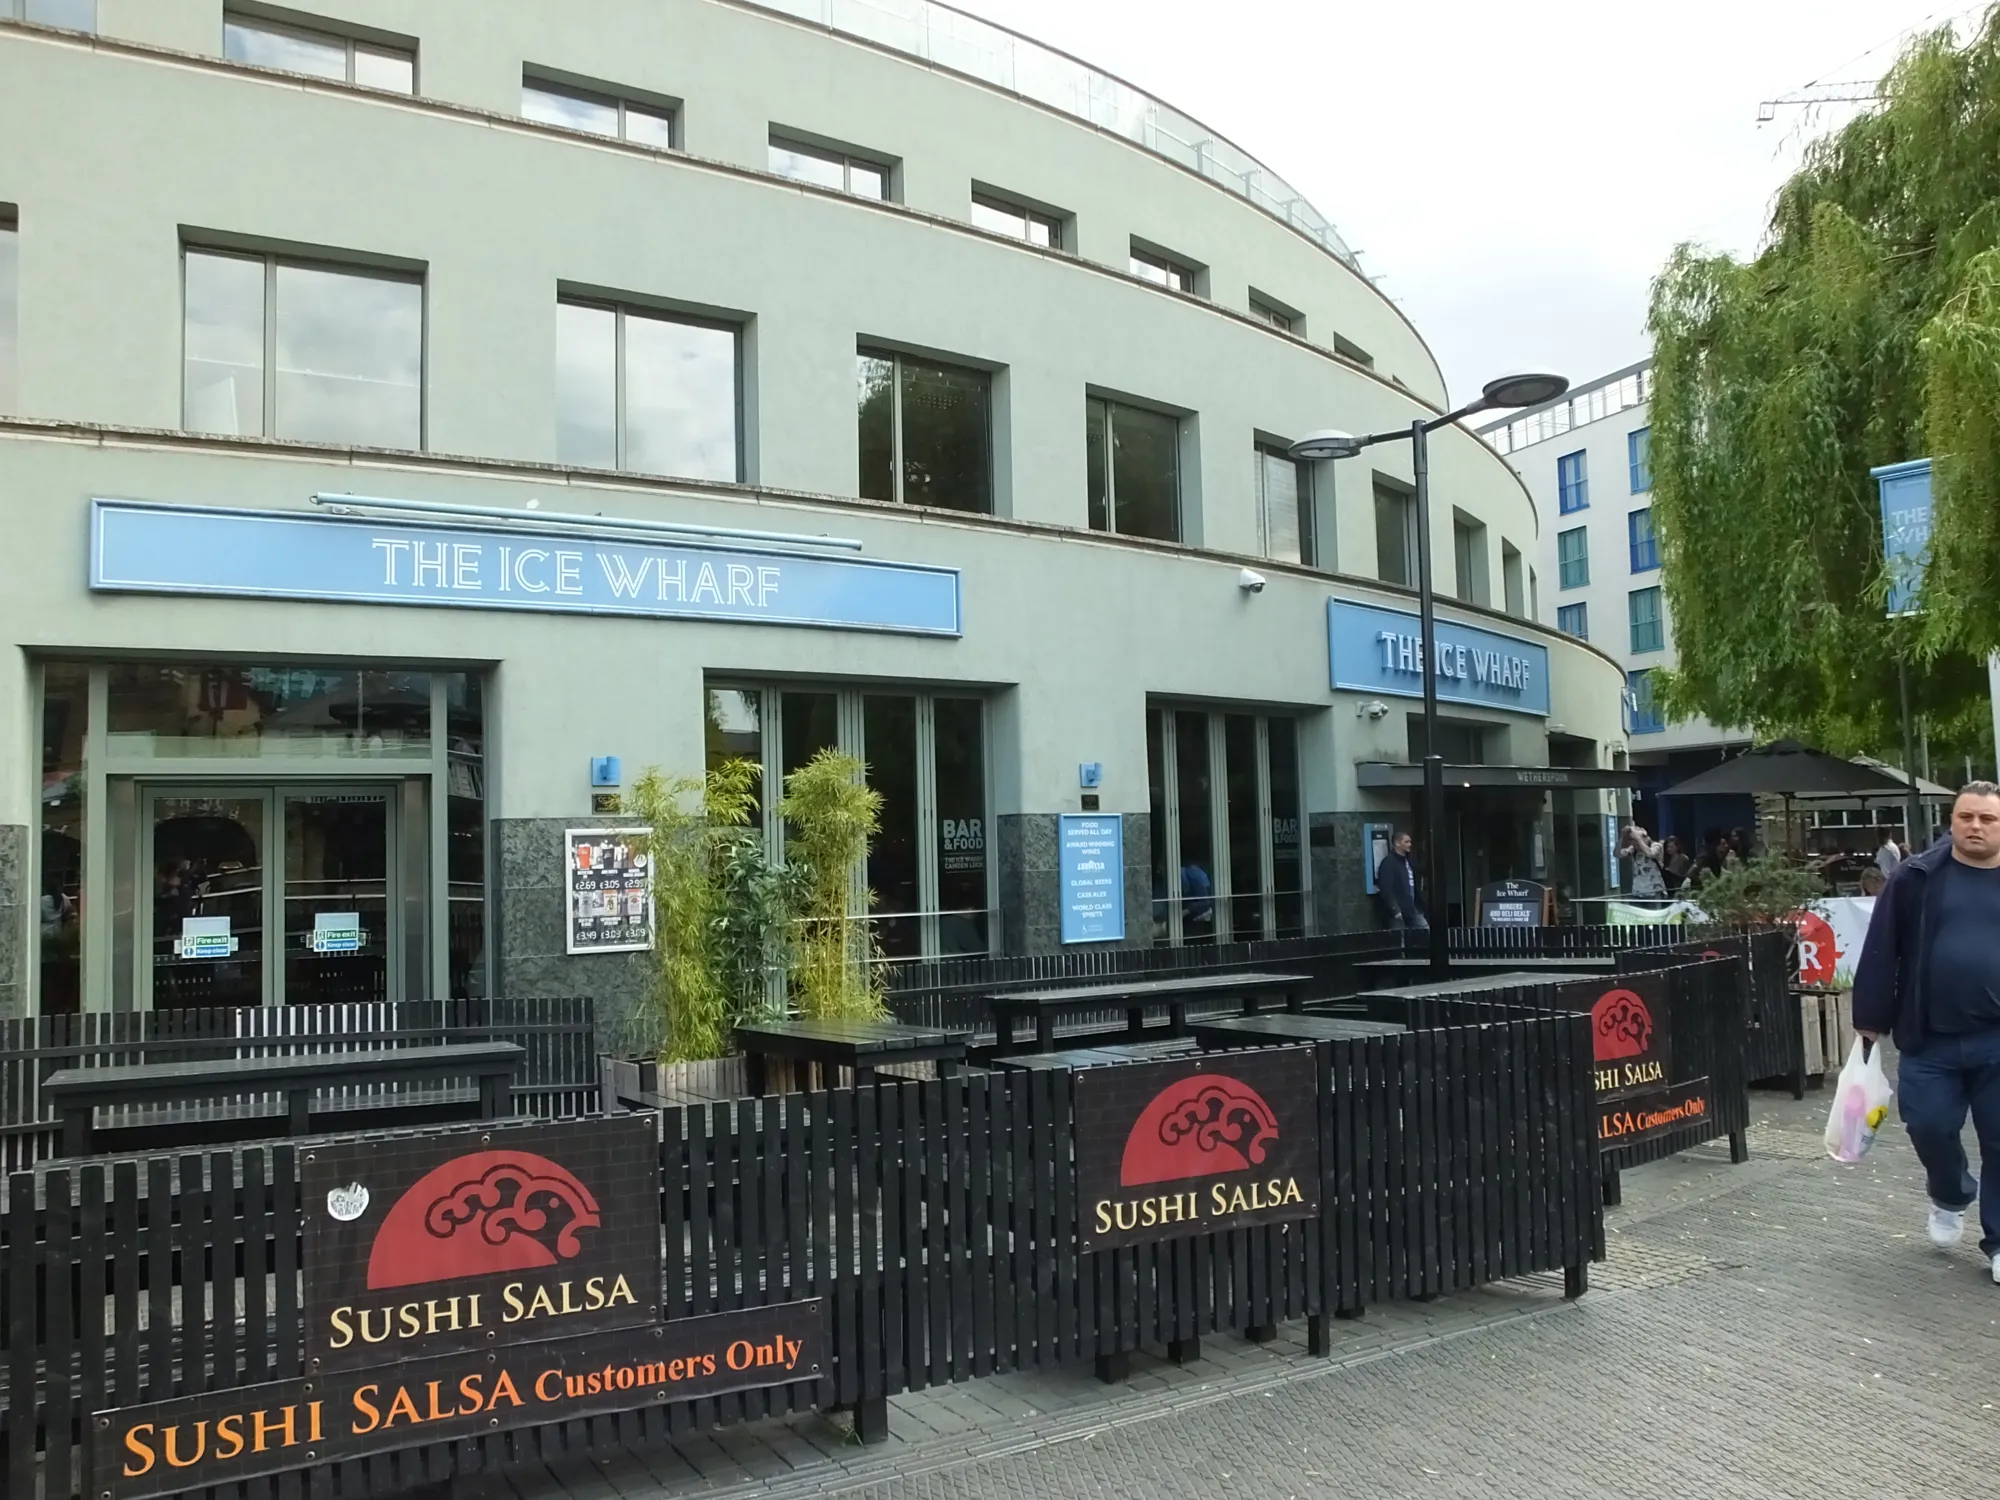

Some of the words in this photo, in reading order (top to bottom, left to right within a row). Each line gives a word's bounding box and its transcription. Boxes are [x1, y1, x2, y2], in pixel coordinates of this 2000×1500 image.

[372, 538, 482, 590] THE
[498, 546, 583, 595] ICE
[596, 553, 781, 607] WHARF
[1378, 631, 1424, 673] THE
[1434, 640, 1467, 679] ICE
[1471, 648, 1530, 690] WHARF
[1516, 771, 1568, 782] WETHERSPOON
[943, 818, 982, 838] BAR
[1274, 818, 1298, 833] BAR
[1507, 889, 1529, 897] Wharf
[212, 936, 228, 944] exit
[1625, 1061, 1663, 1086] SALSA
[1637, 1104, 1684, 1130] Customers
[1685, 1096, 1705, 1116] Only
[1095, 1191, 1199, 1234] SUSHI
[1211, 1176, 1304, 1216] SALSA
[329, 1293, 483, 1349] SUSHI
[502, 1273, 639, 1323] SALSA
[122, 1399, 326, 1477] SUSHI
[351, 1369, 526, 1435] SALSA
[534, 1351, 717, 1403] Customers
[726, 1334, 804, 1371] Only
